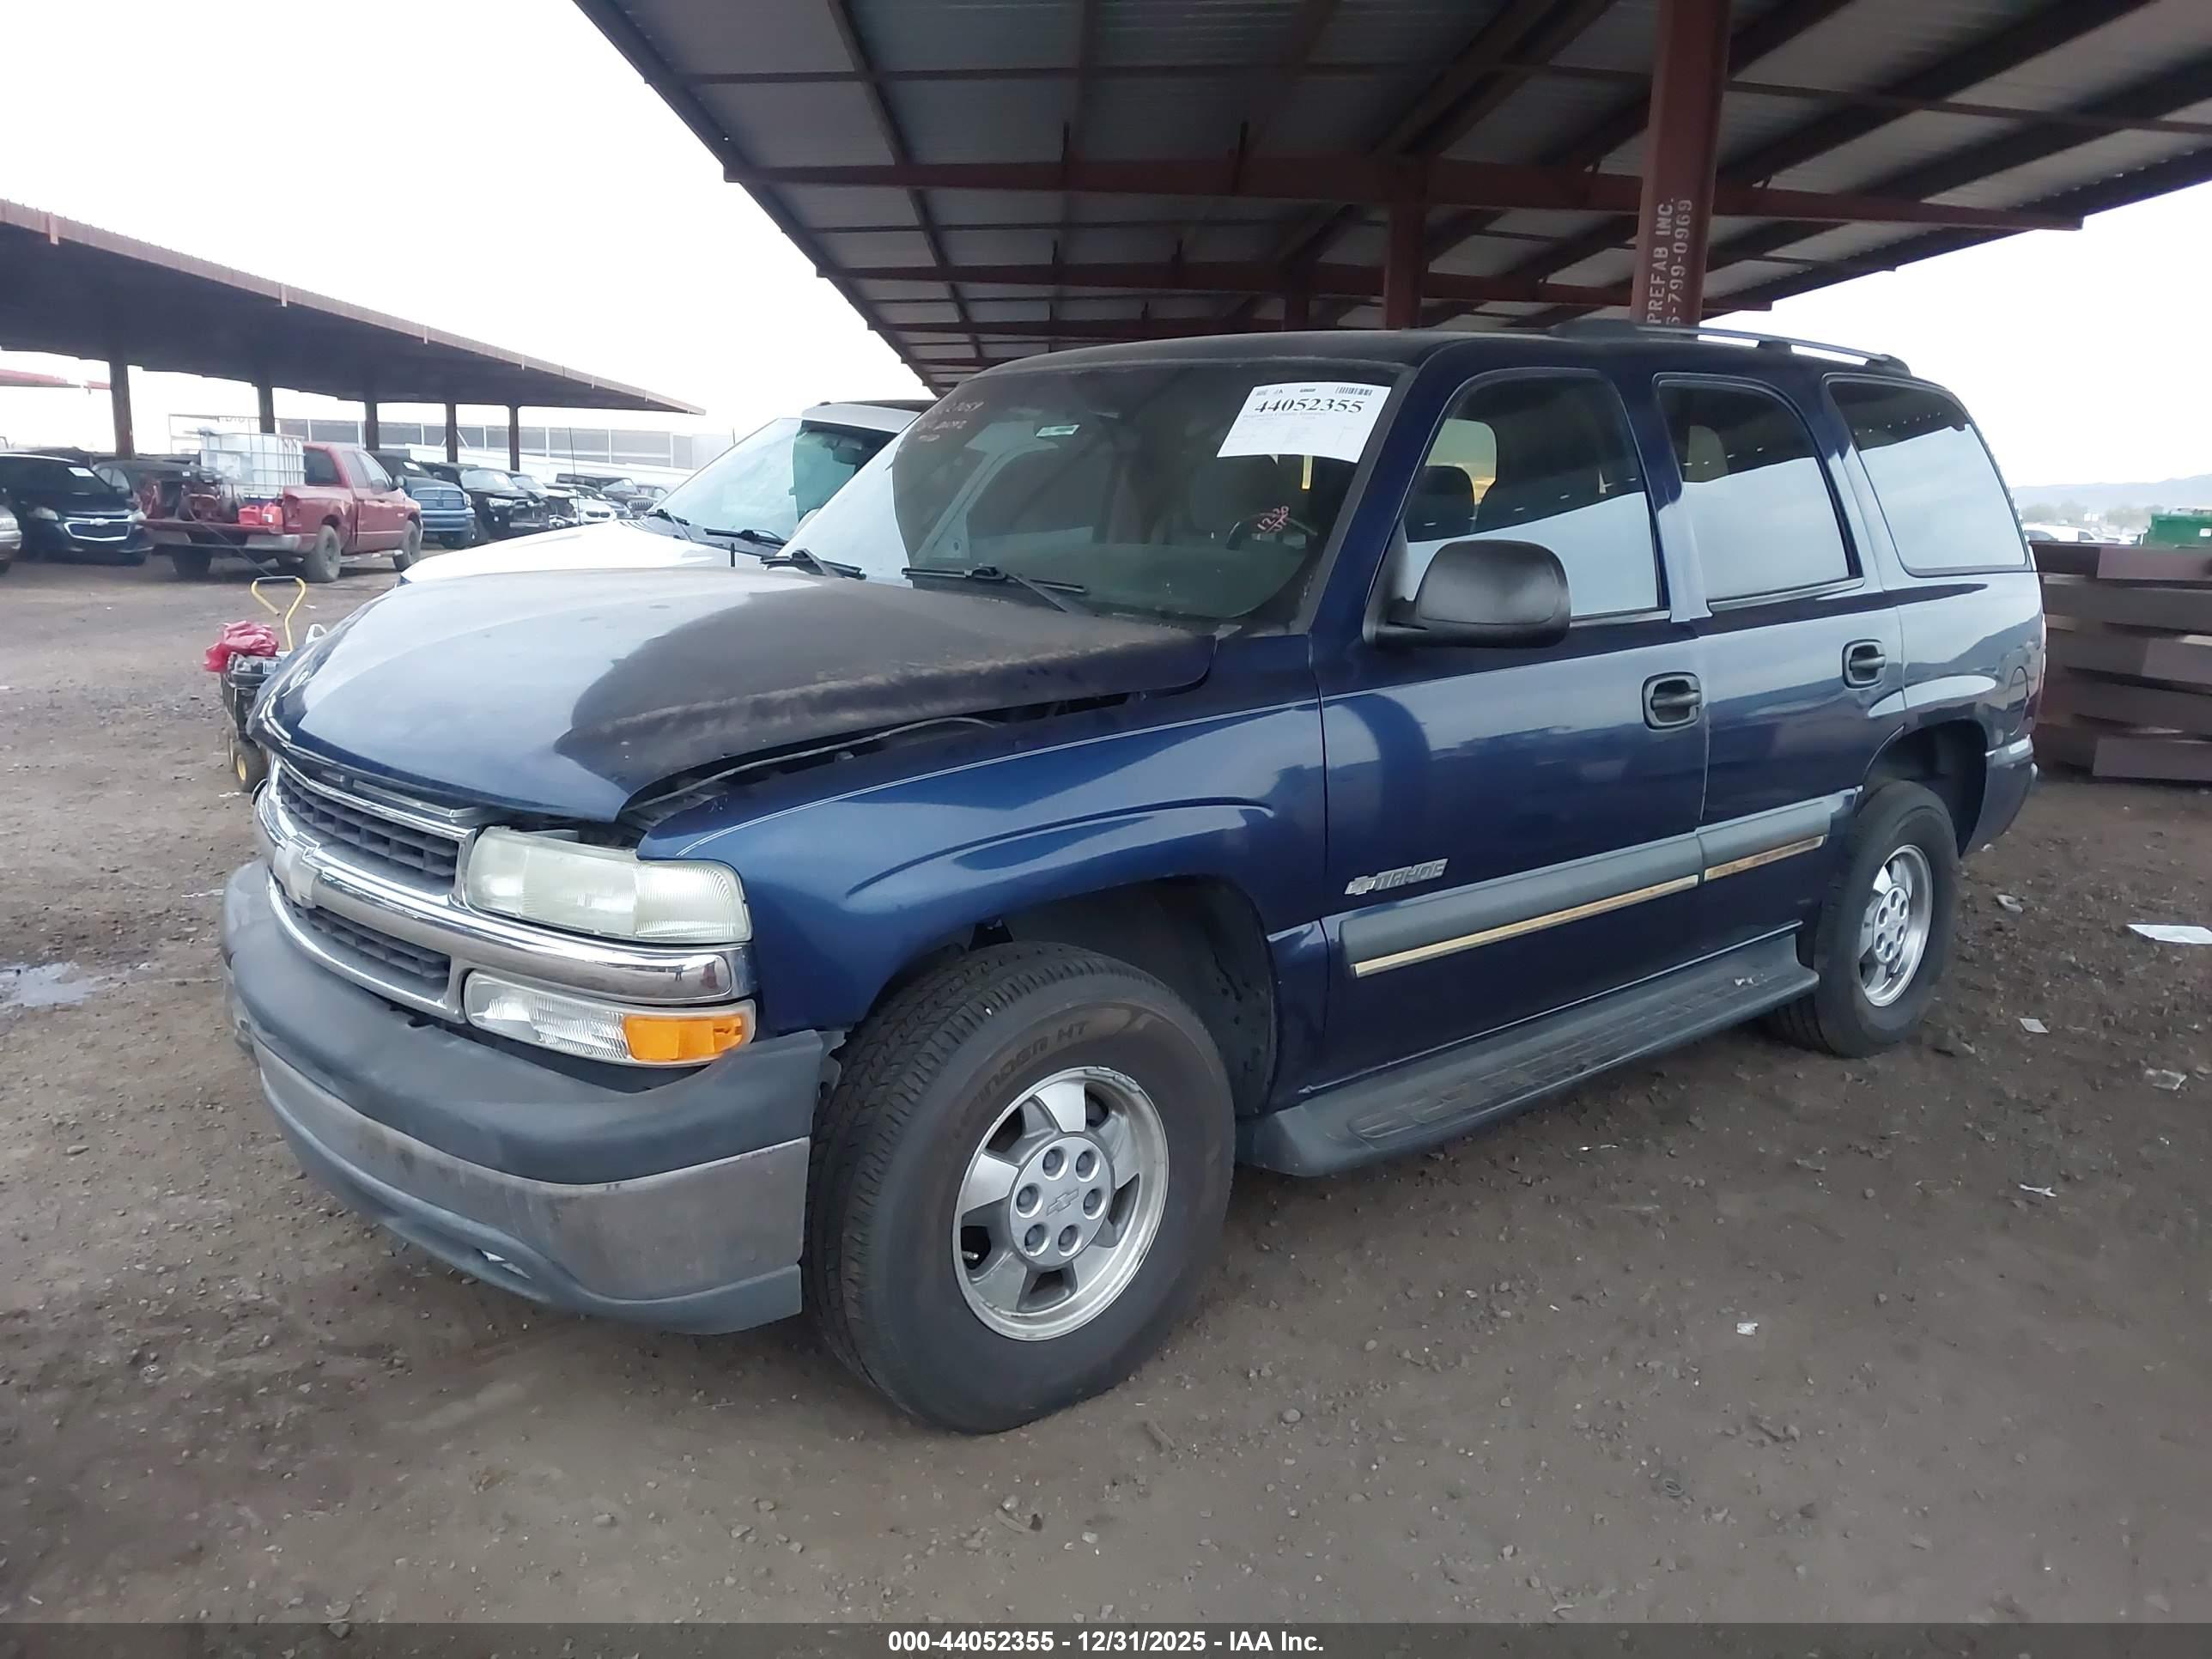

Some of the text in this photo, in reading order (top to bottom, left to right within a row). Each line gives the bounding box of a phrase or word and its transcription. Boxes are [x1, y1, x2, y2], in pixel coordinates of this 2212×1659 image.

[1646, 198, 1674, 324] PREFAB INC.
[1254, 398, 1364, 414] 44052355
[1376, 859, 1449, 890] TAHOE
